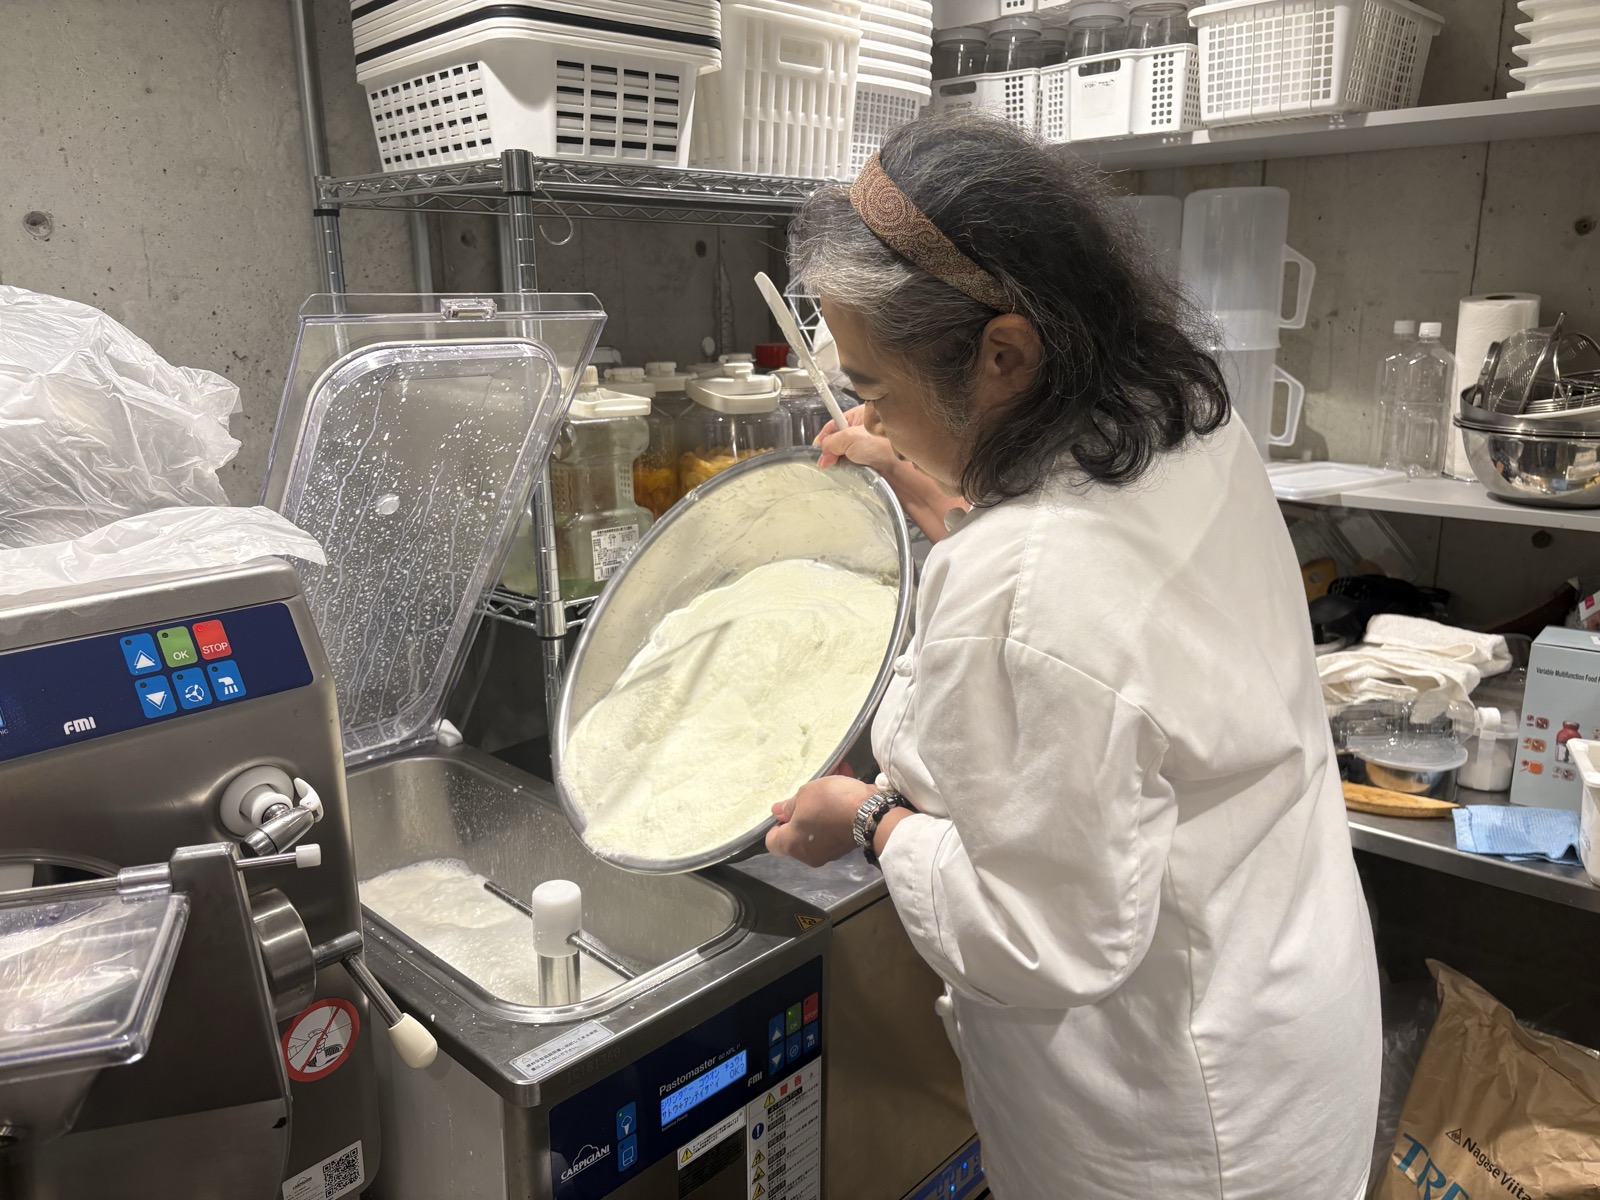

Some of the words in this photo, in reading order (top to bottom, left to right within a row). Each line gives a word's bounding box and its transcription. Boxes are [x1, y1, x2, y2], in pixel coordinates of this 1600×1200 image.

[173, 650, 189, 661] OK
[202, 642, 228, 655] STOP
[1536, 666, 1554, 676] Variable
[1555, 669, 1585, 681] Multifunction
[1585, 674, 1598, 683] Food
[63, 716, 97, 735] FMI
[659, 1056, 717, 1096] Pastomaster
[729, 1063, 745, 1080] OK?
[747, 1071, 763, 1088] FMI
[561, 1144, 610, 1180] CARPIGIANI
[1462, 1137, 1501, 1179] Nagase
[1501, 1172, 1533, 1200] Viita
